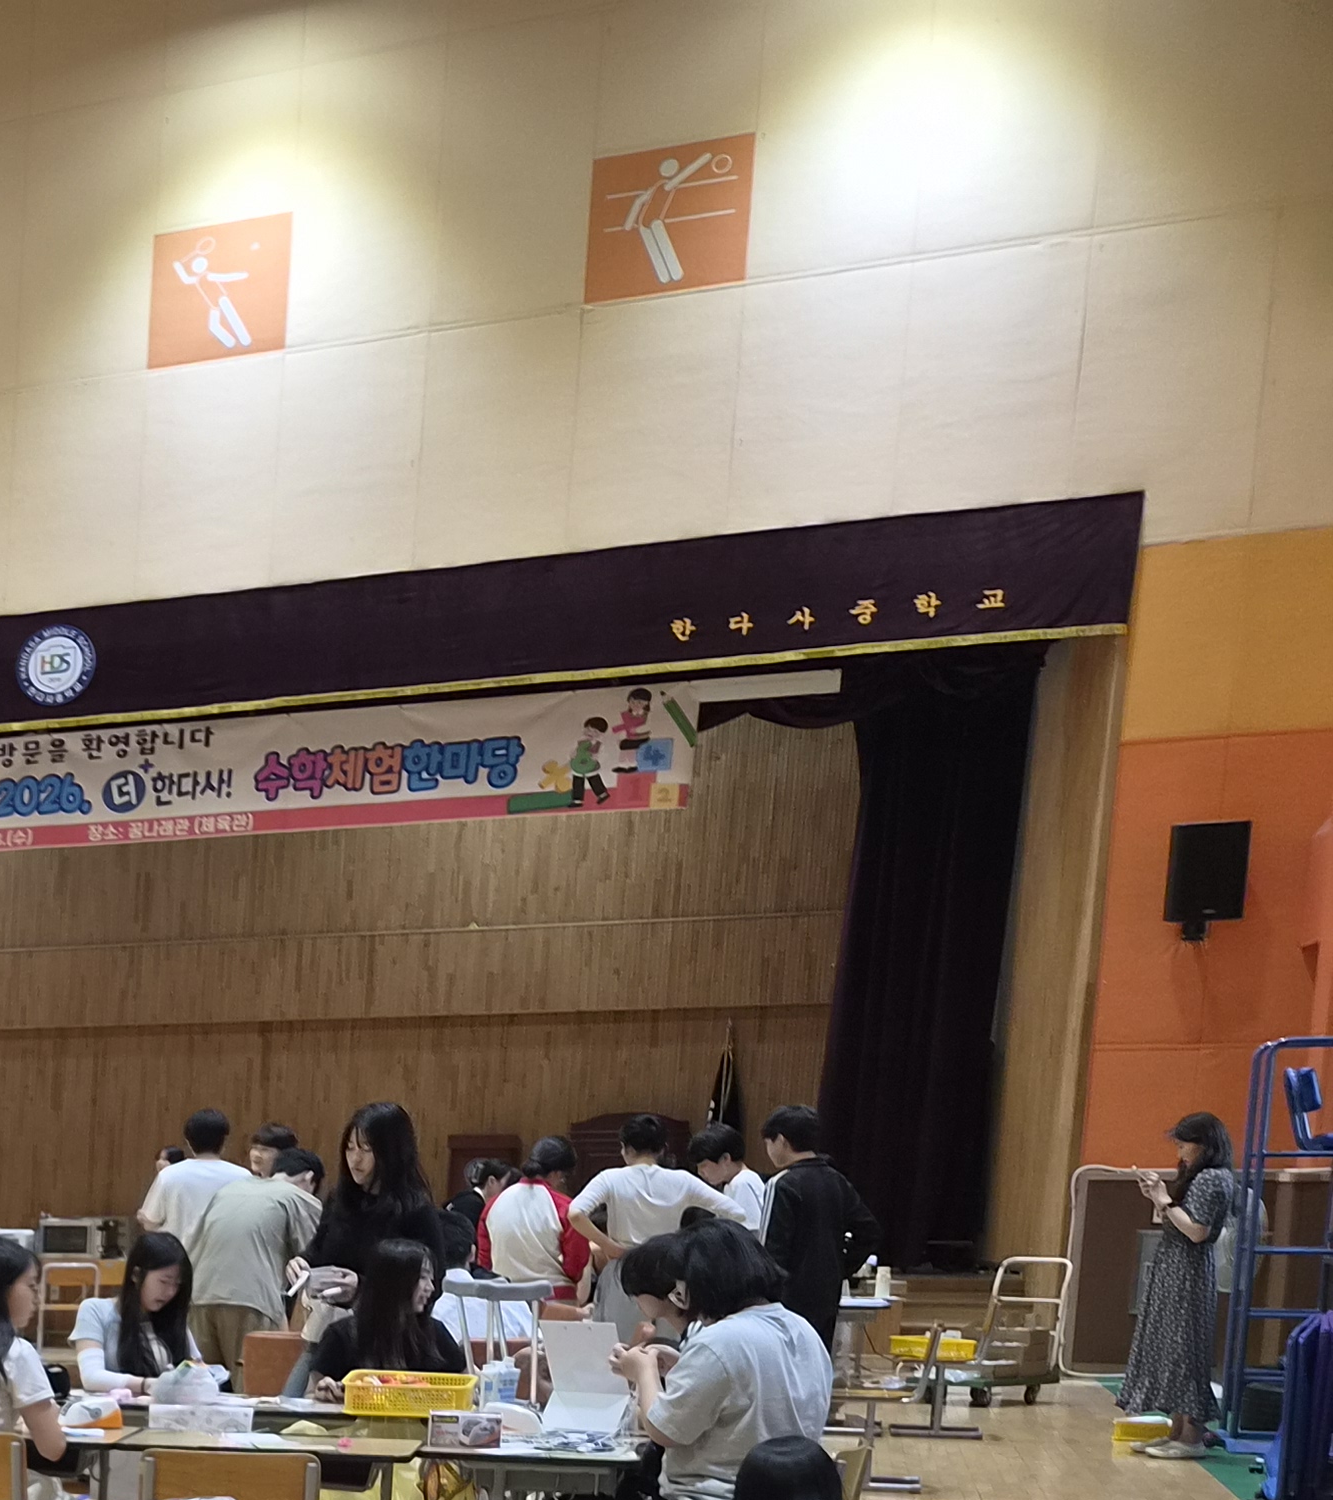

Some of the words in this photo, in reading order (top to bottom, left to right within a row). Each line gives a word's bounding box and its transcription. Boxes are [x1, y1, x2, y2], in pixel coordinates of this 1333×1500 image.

[670, 588, 1006, 641] 한다사중학교
[81, 726, 214, 759] 환영합니다
[151, 767, 234, 807] 한다사!
[254, 736, 525, 801] 수학체험한마당
